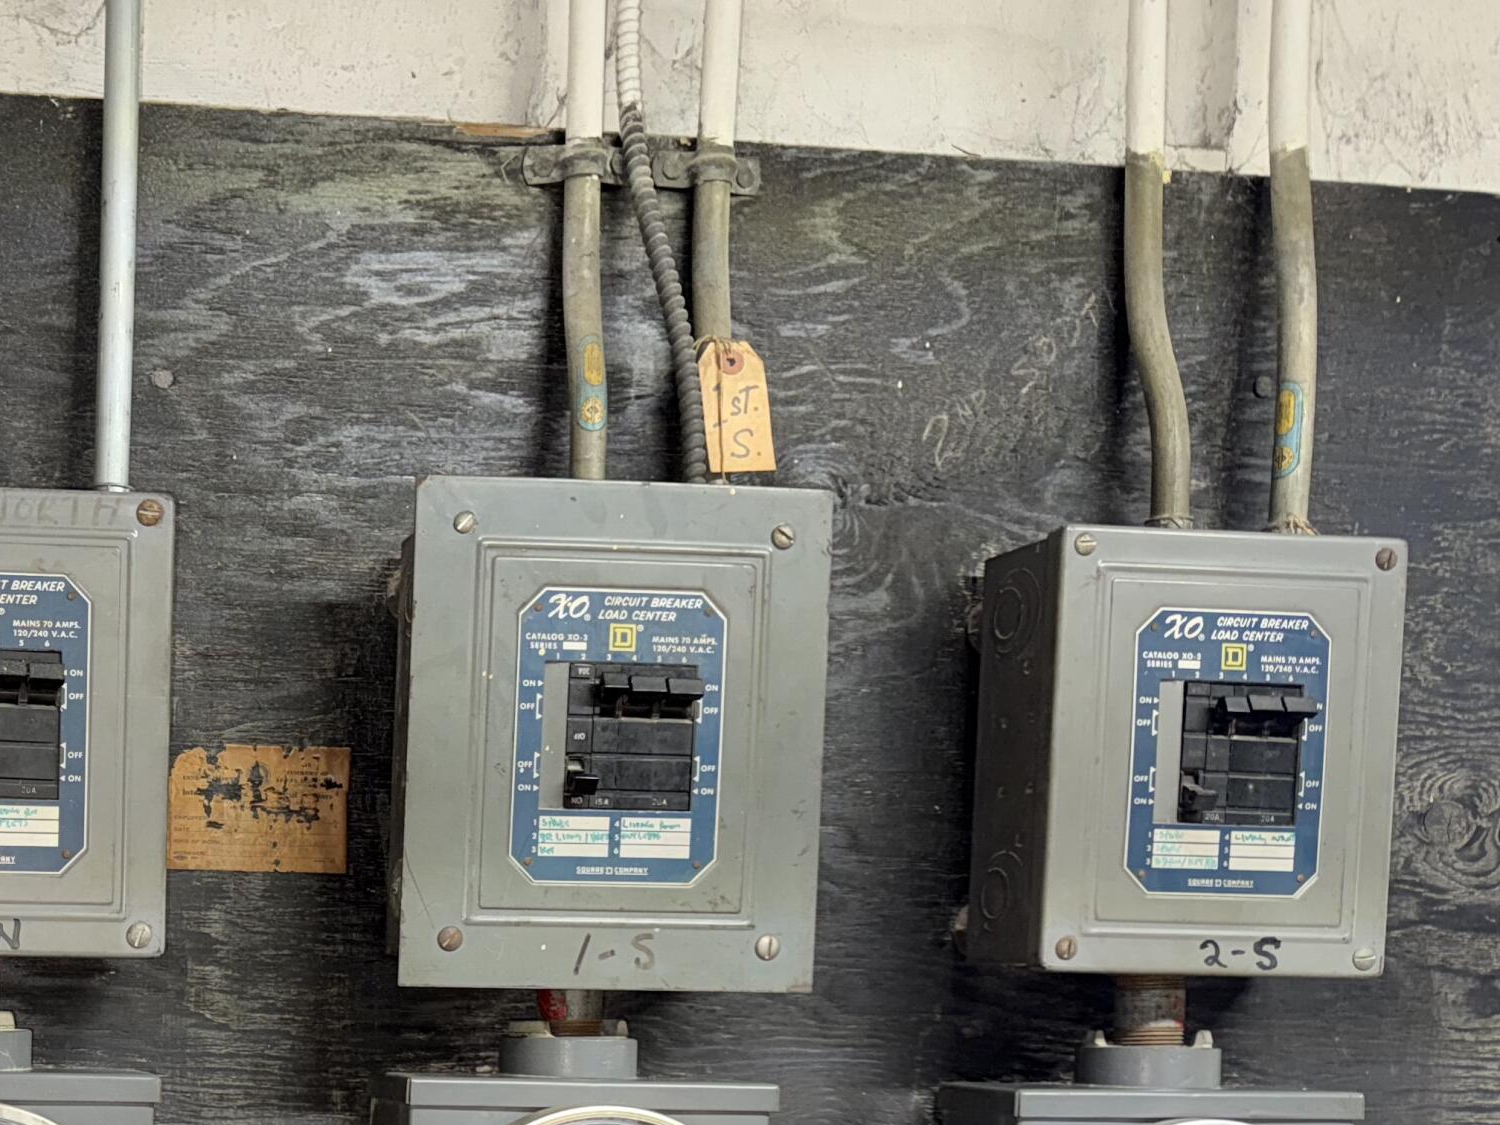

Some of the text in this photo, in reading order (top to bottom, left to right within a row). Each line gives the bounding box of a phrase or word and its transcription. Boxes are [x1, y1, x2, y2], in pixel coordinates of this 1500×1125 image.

[10, 580, 66, 592] BREAKER
[548, 593, 590, 619] XO
[604, 596, 704, 609] CIRCUIT BREAKER
[598, 609, 677, 622] LOAD CENTER
[12, 619, 41, 628] MAINS
[42, 620, 53, 628] 70
[1164, 614, 1204, 640] XO
[1216, 616, 1309, 630] CIRCUIT BREAKER
[13, 629, 78, 639] 120/240 V.A.C.
[525, 632, 565, 641] CATALOG
[1211, 630, 1284, 643] LOAD CENTER
[652, 636, 679, 644] MAINS
[681, 637, 692, 645] 70
[652, 644, 715, 654] 120/240 V.A.C.
[1142, 651, 1179, 659] CATALOG
[1260, 655, 1286, 664] MAINS
[1287, 656, 1297, 664] 70
[69, 669, 84, 677] ON
[1261, 664, 1319, 674] 120/240 V.A.C.
[68, 692, 84, 700] OFF
[576, 866, 604, 874] SQUARE
[614, 867, 649, 875] COMPANY
[1188, 878, 1213, 887] SQUARE
[1223, 879, 1254, 888] COMPANY
[1199, 936, 1282, 971] 2-S
